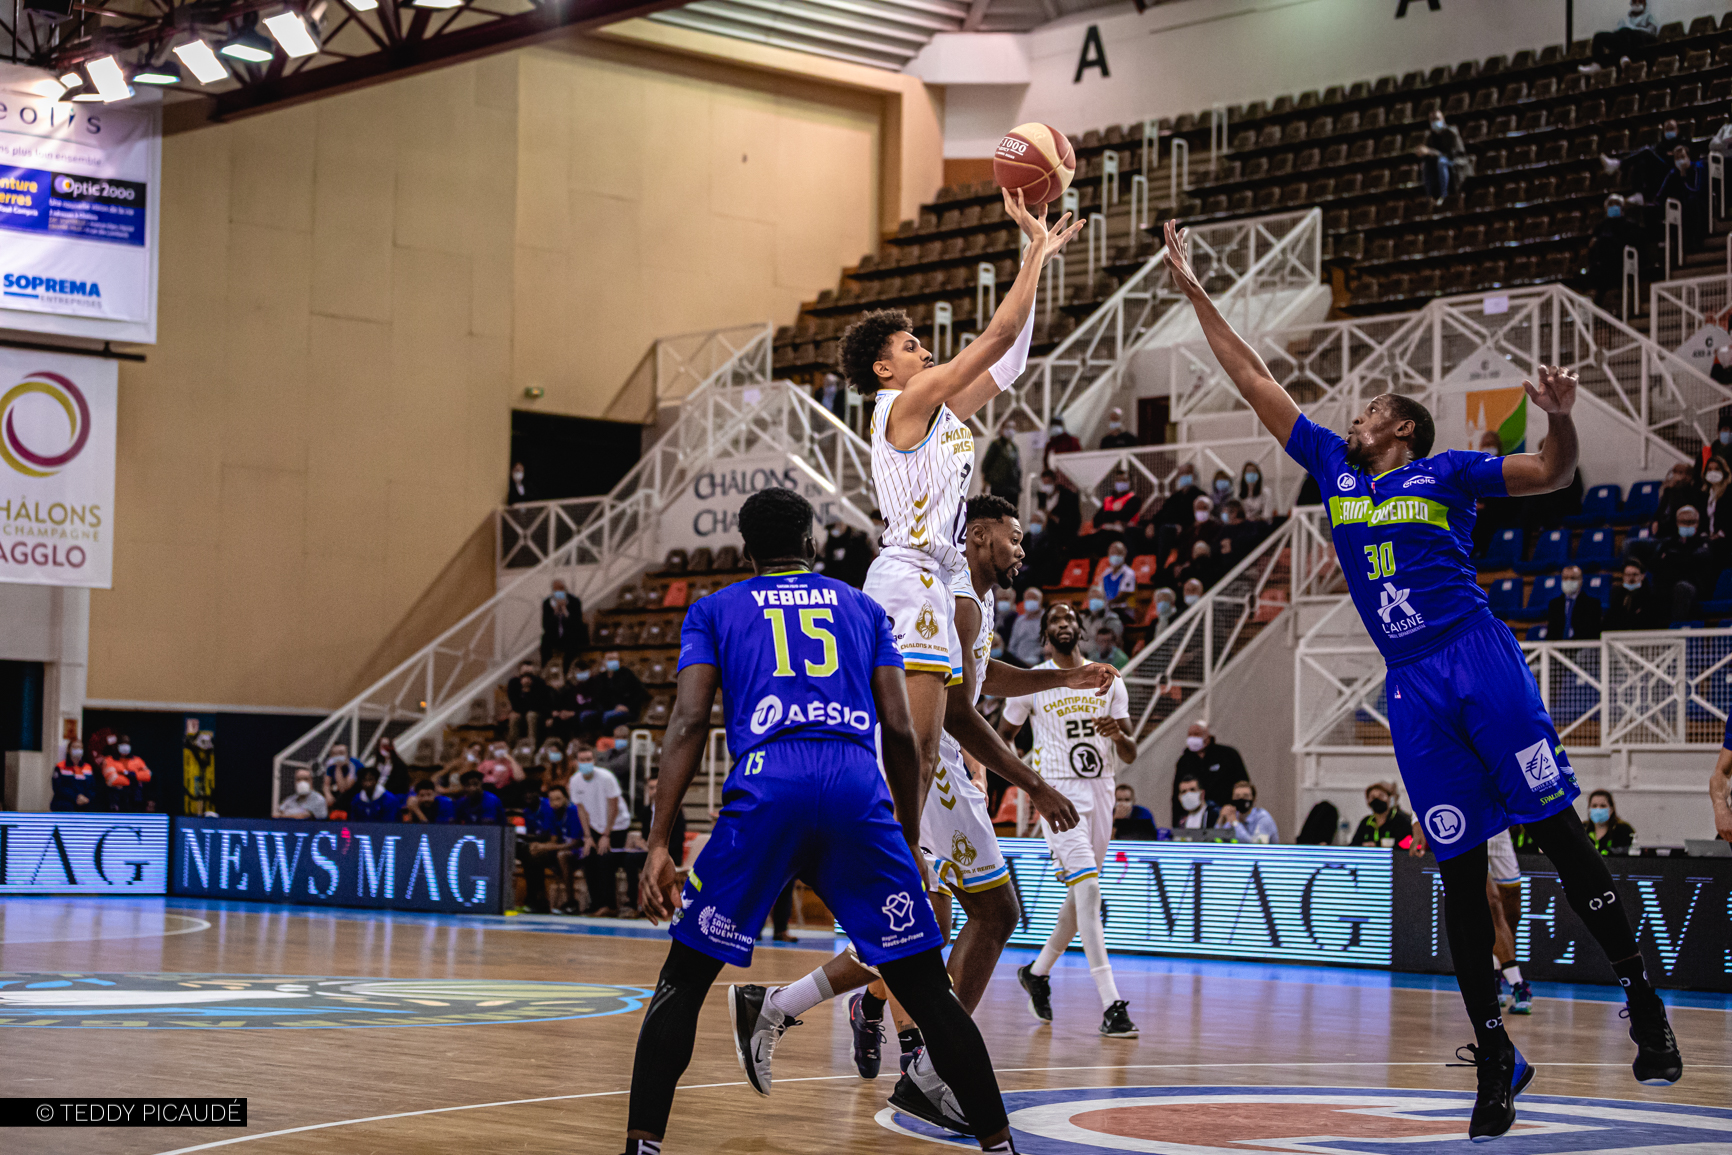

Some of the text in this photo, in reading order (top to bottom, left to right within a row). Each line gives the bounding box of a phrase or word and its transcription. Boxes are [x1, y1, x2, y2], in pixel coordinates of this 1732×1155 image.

[1073, 25, 1110, 83] A
[101, 182, 135, 200] 2000
[3, 273, 101, 298] SOPREMA
[3, 523, 99, 542] CHAMPAGNE
[1364, 541, 1396, 580] 30
[751, 588, 838, 607] YEBOAH
[763, 608, 839, 677] 15
[1043, 695, 1107, 714] CHAMPAGNE
[1056, 704, 1099, 718] BASKET
[1066, 718, 1096, 740] 25
[744, 750, 766, 777] 15
[712, 917, 738, 932] SAINT
